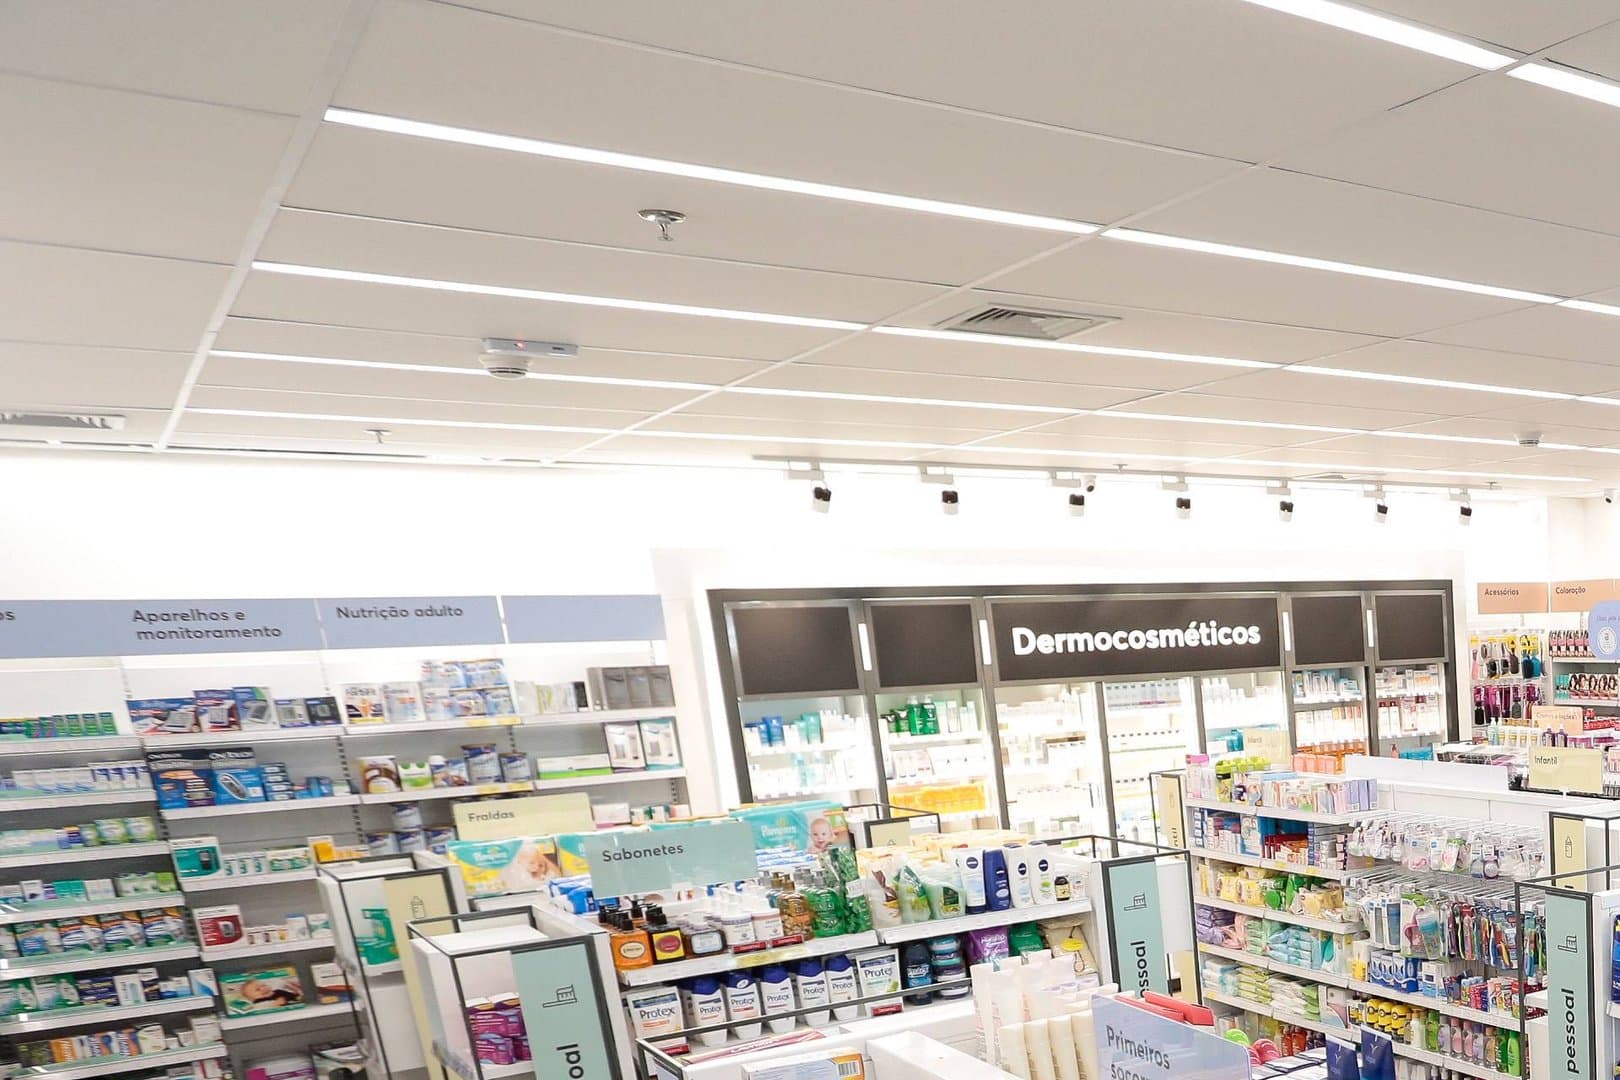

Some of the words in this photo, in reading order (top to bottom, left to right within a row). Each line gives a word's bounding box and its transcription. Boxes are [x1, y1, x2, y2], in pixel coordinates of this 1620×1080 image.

[132, 608, 229, 623] Aparelhos
[235, 611, 247, 621] e
[336, 605, 410, 620] Nutrição
[415, 605, 464, 618] adulto
[136, 626, 282, 641] monitoramento
[1011, 622, 1262, 658] Dermocosméticos
[1534, 755, 1558, 766] Infantil
[468, 810, 515, 822] Fraldas
[602, 843, 684, 863] Sabonetes
[639, 1006, 676, 1021] Protex
[1561, 988, 1580, 1074] pessoal
[1106, 1025, 1170, 1071] Primeiros
